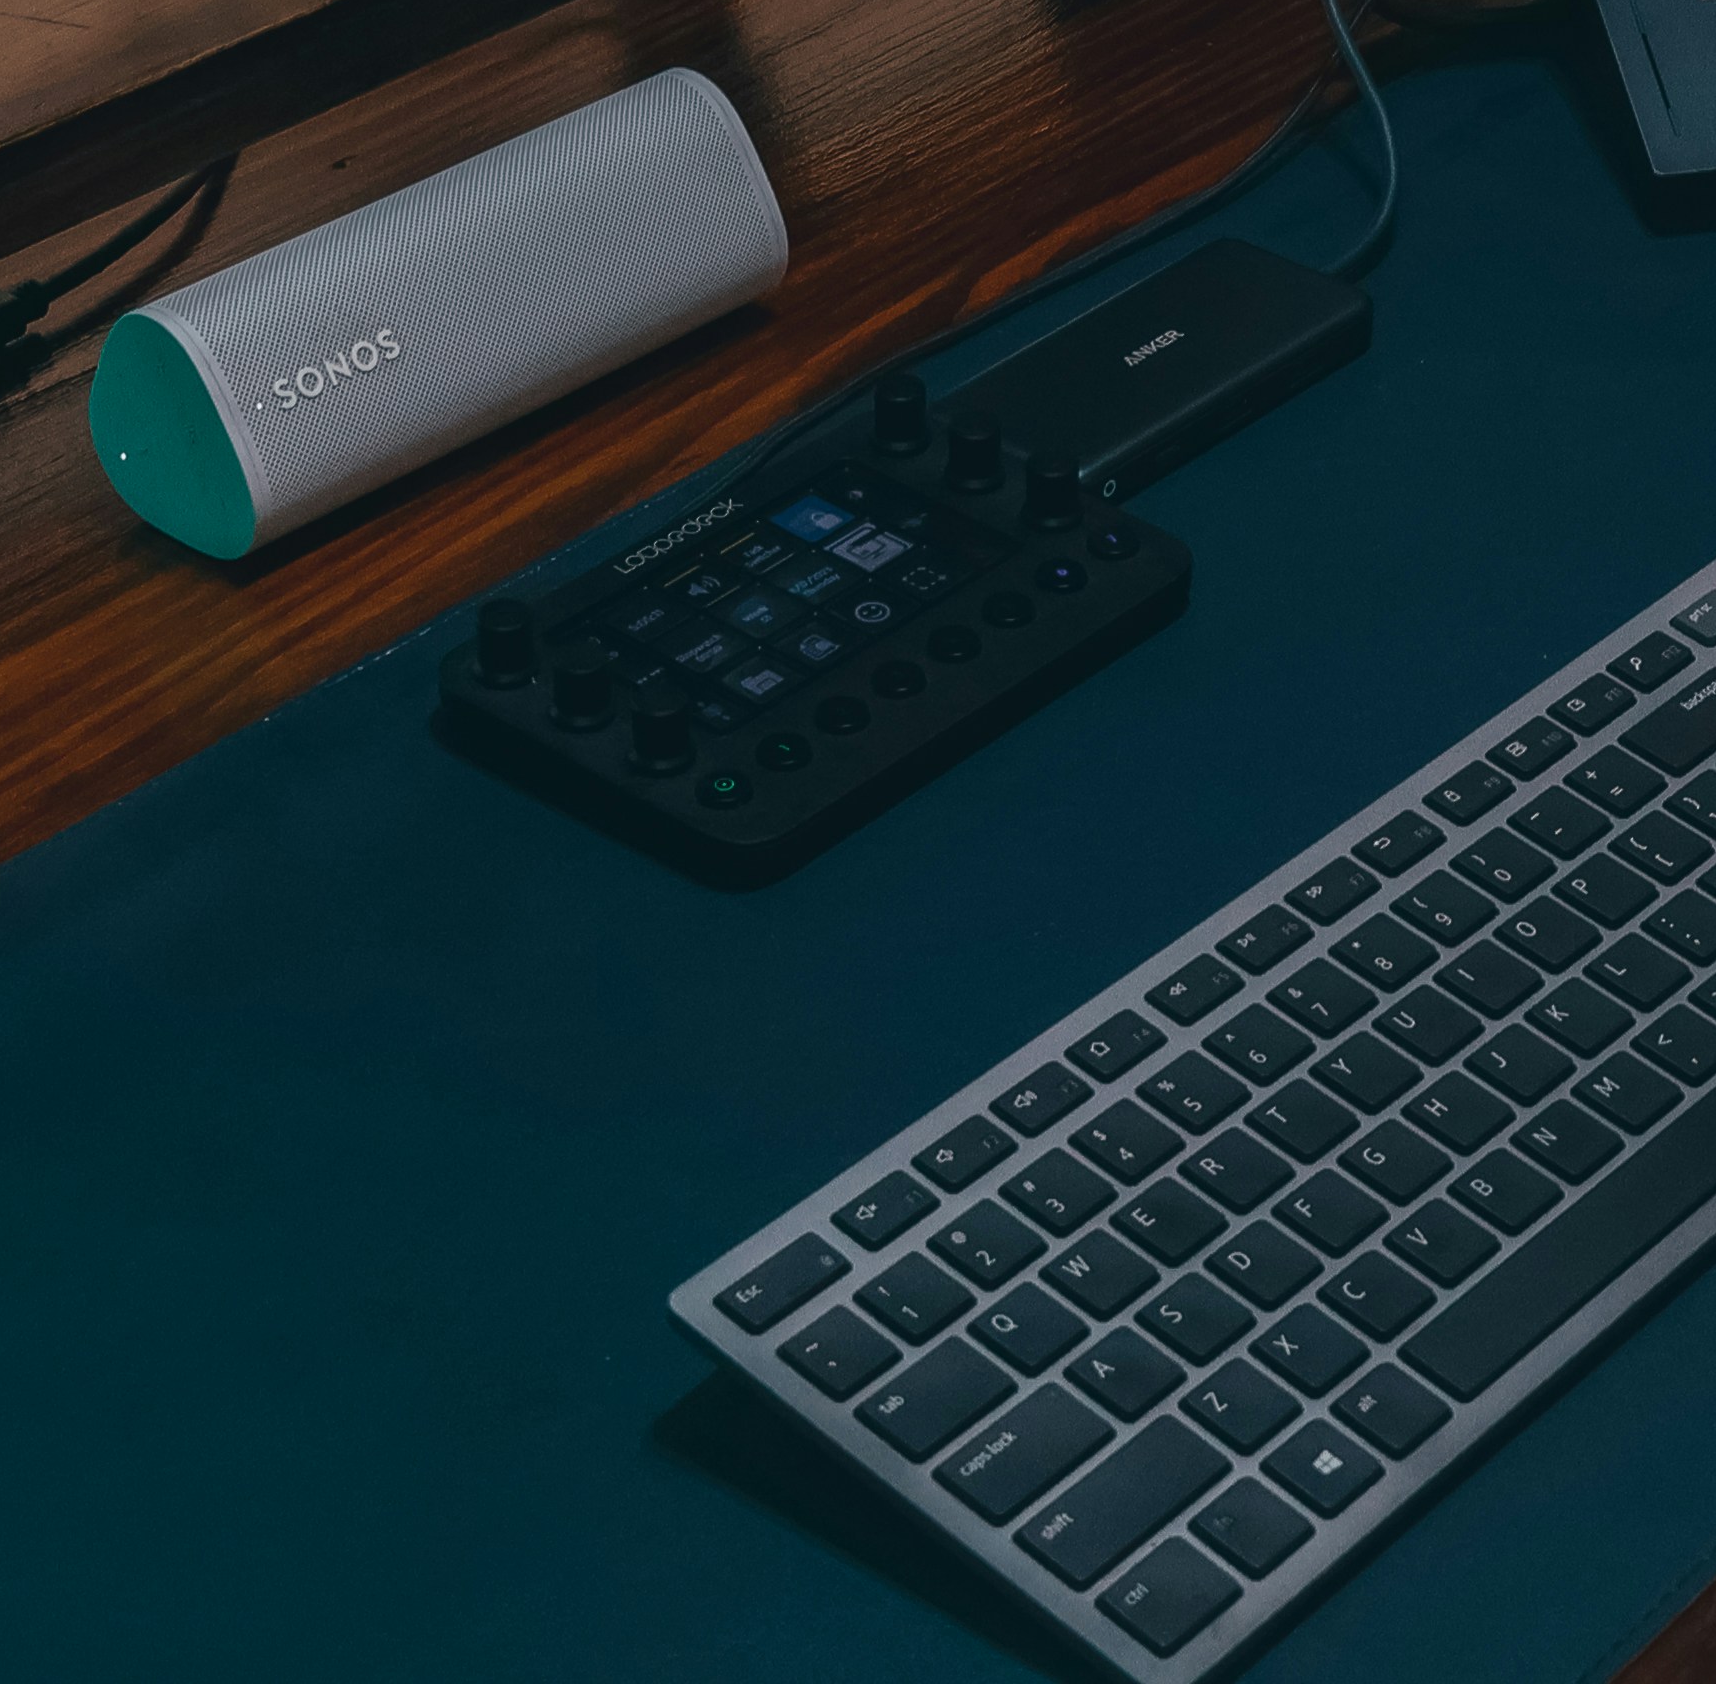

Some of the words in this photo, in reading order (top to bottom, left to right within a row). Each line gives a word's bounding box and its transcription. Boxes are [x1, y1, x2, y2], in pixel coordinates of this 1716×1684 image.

[1124, 330, 1185, 367] ANKER
[273, 328, 401, 410] SONOS
[735, 1283, 764, 1304] Esc
[878, 1393, 905, 1416] tab
[959, 1450, 989, 1478] caps
[985, 1429, 1018, 1456] lock
[1040, 1512, 1075, 1541] shift
